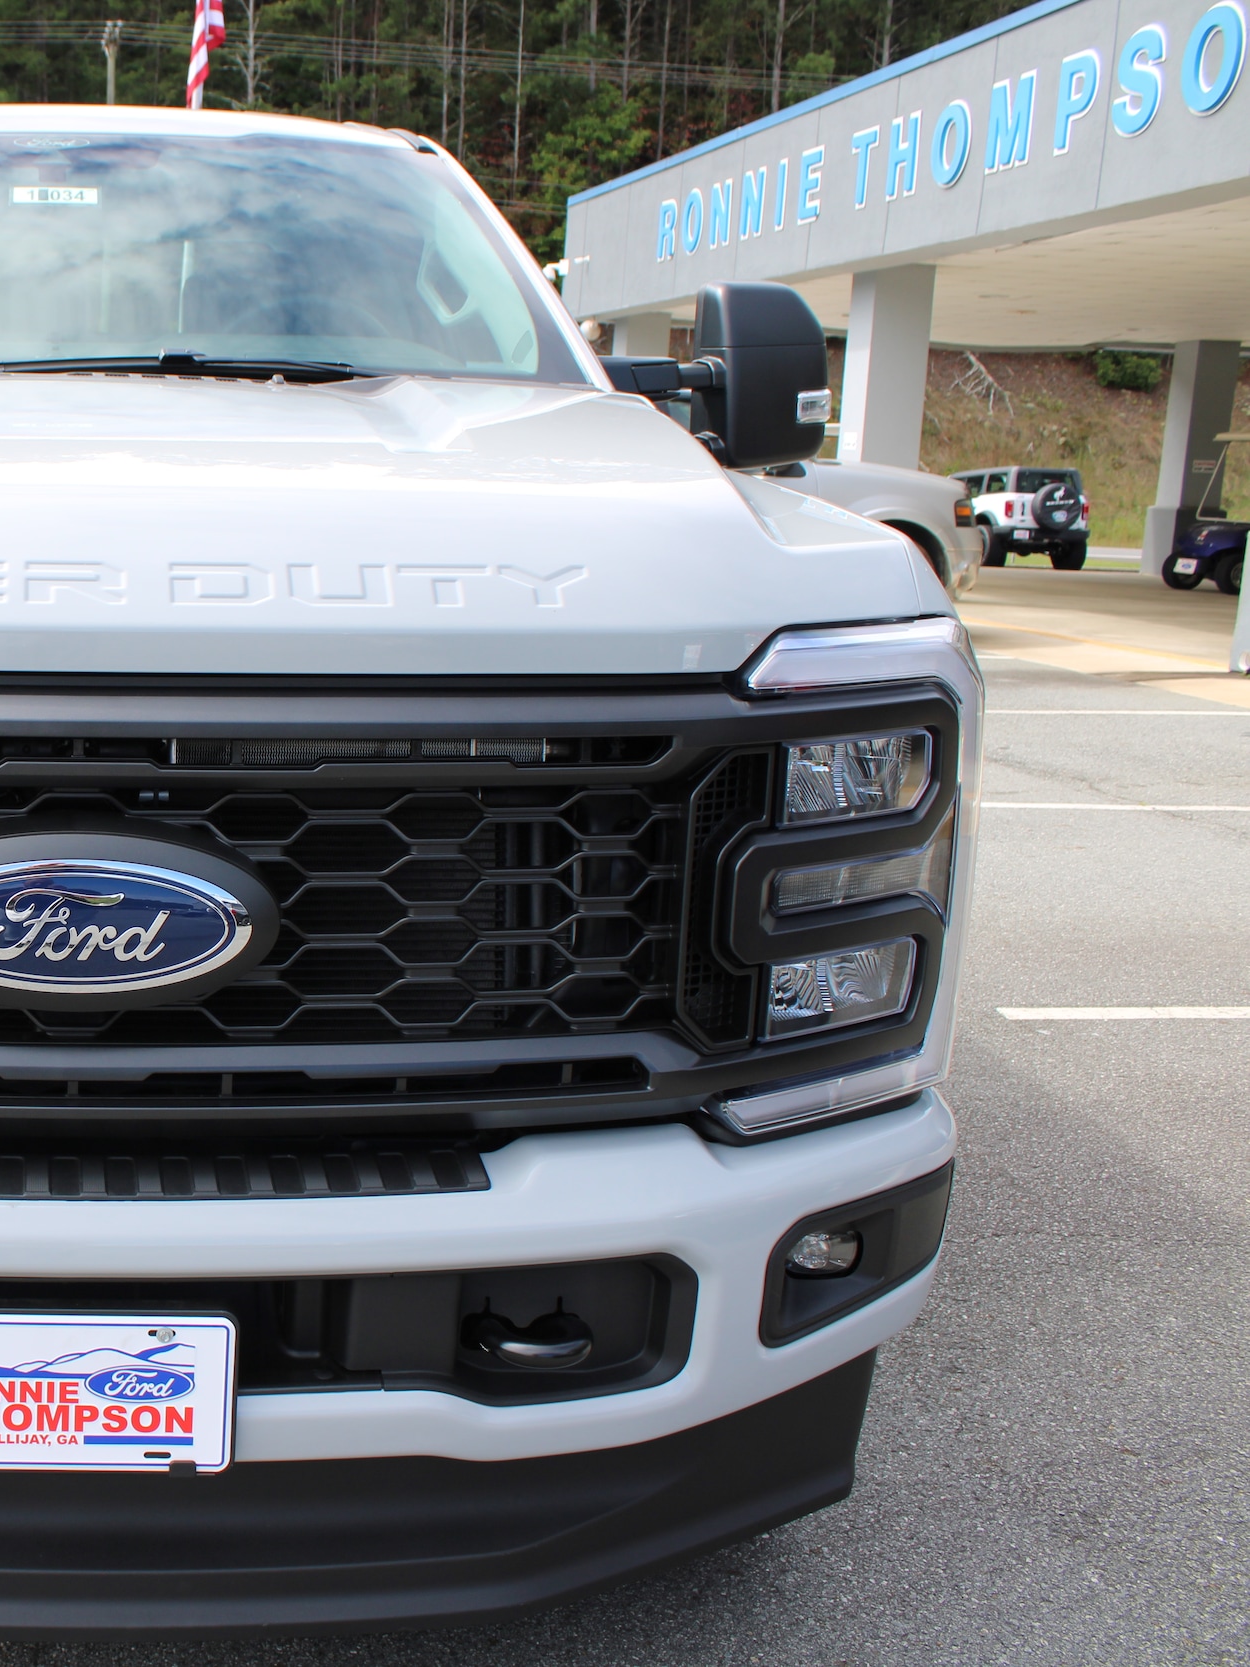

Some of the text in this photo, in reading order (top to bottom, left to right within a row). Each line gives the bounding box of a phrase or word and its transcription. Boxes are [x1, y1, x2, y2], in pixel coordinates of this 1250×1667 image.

[657, 0, 1247, 262] RONNIE THOMPSO
[28, 188, 85, 201] 1034
[168, 561, 589, 608] DUTY
[104, 1370, 172, 1398] Ford
[56, 1434, 78, 1445] GA
